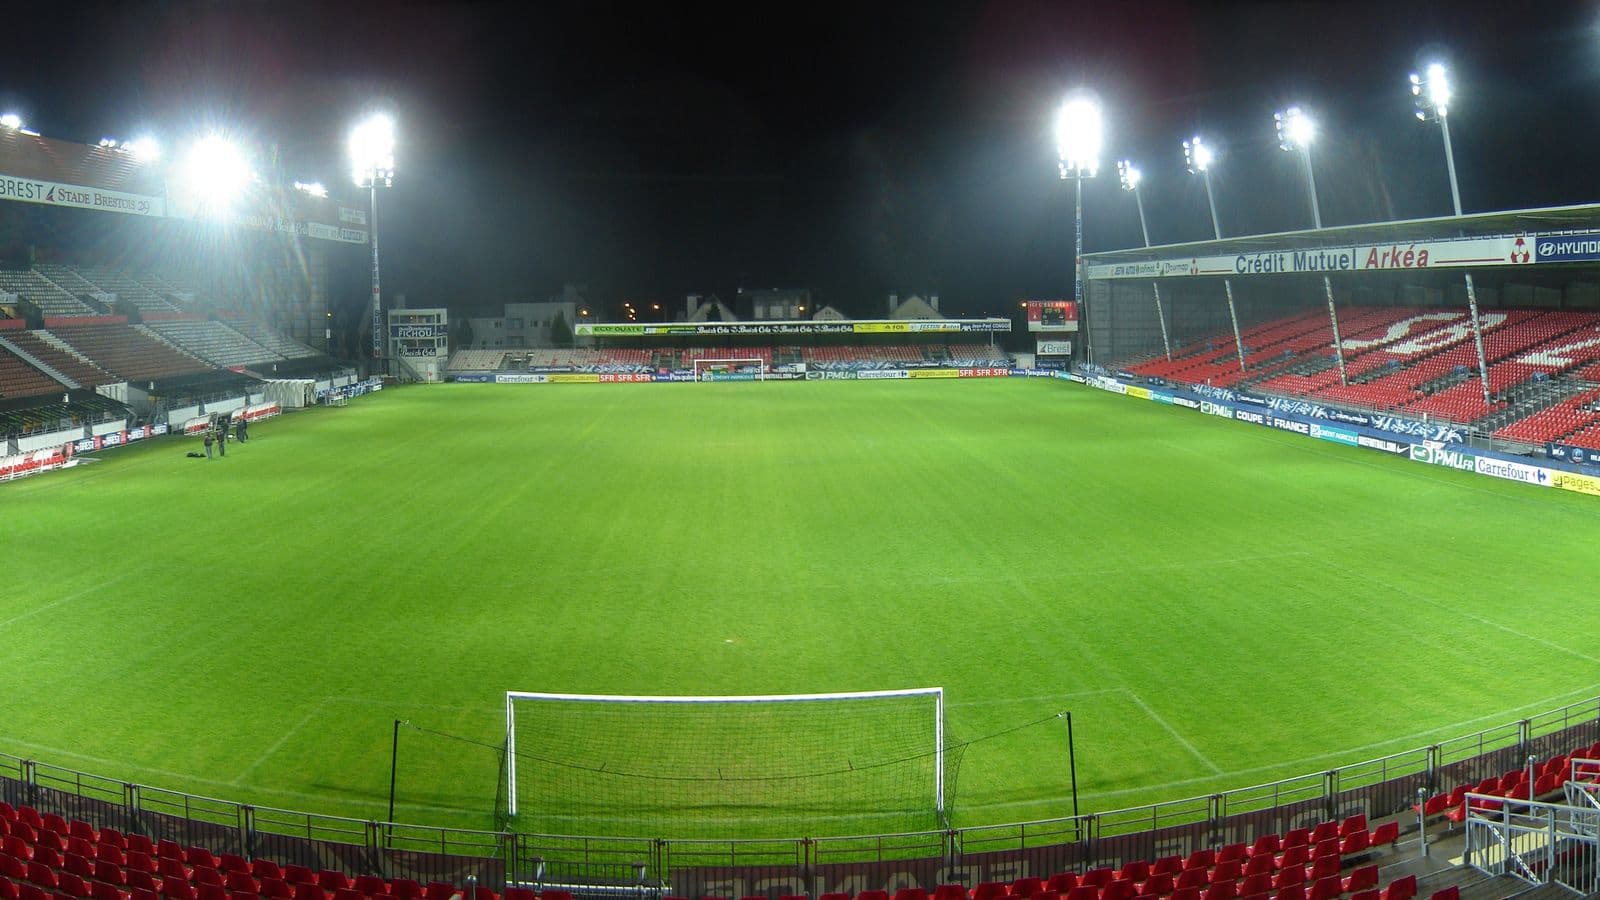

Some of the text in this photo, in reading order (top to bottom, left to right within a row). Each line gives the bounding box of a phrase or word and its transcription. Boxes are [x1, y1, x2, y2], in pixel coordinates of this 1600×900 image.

[137, 201, 151, 214] 29
[1235, 244, 1429, 273] Crédit Mutuel Arkéa
[1047, 344, 1071, 354] Brest
[600, 374, 651, 382] SFR SFR SFR
[858, 370, 897, 378] Carrefour
[959, 368, 1008, 377] SFR SFR SFR
[1236, 410, 1263, 424] COUPE
[1274, 418, 1309, 434] FRANCE
[1478, 458, 1530, 481] Carrefour
